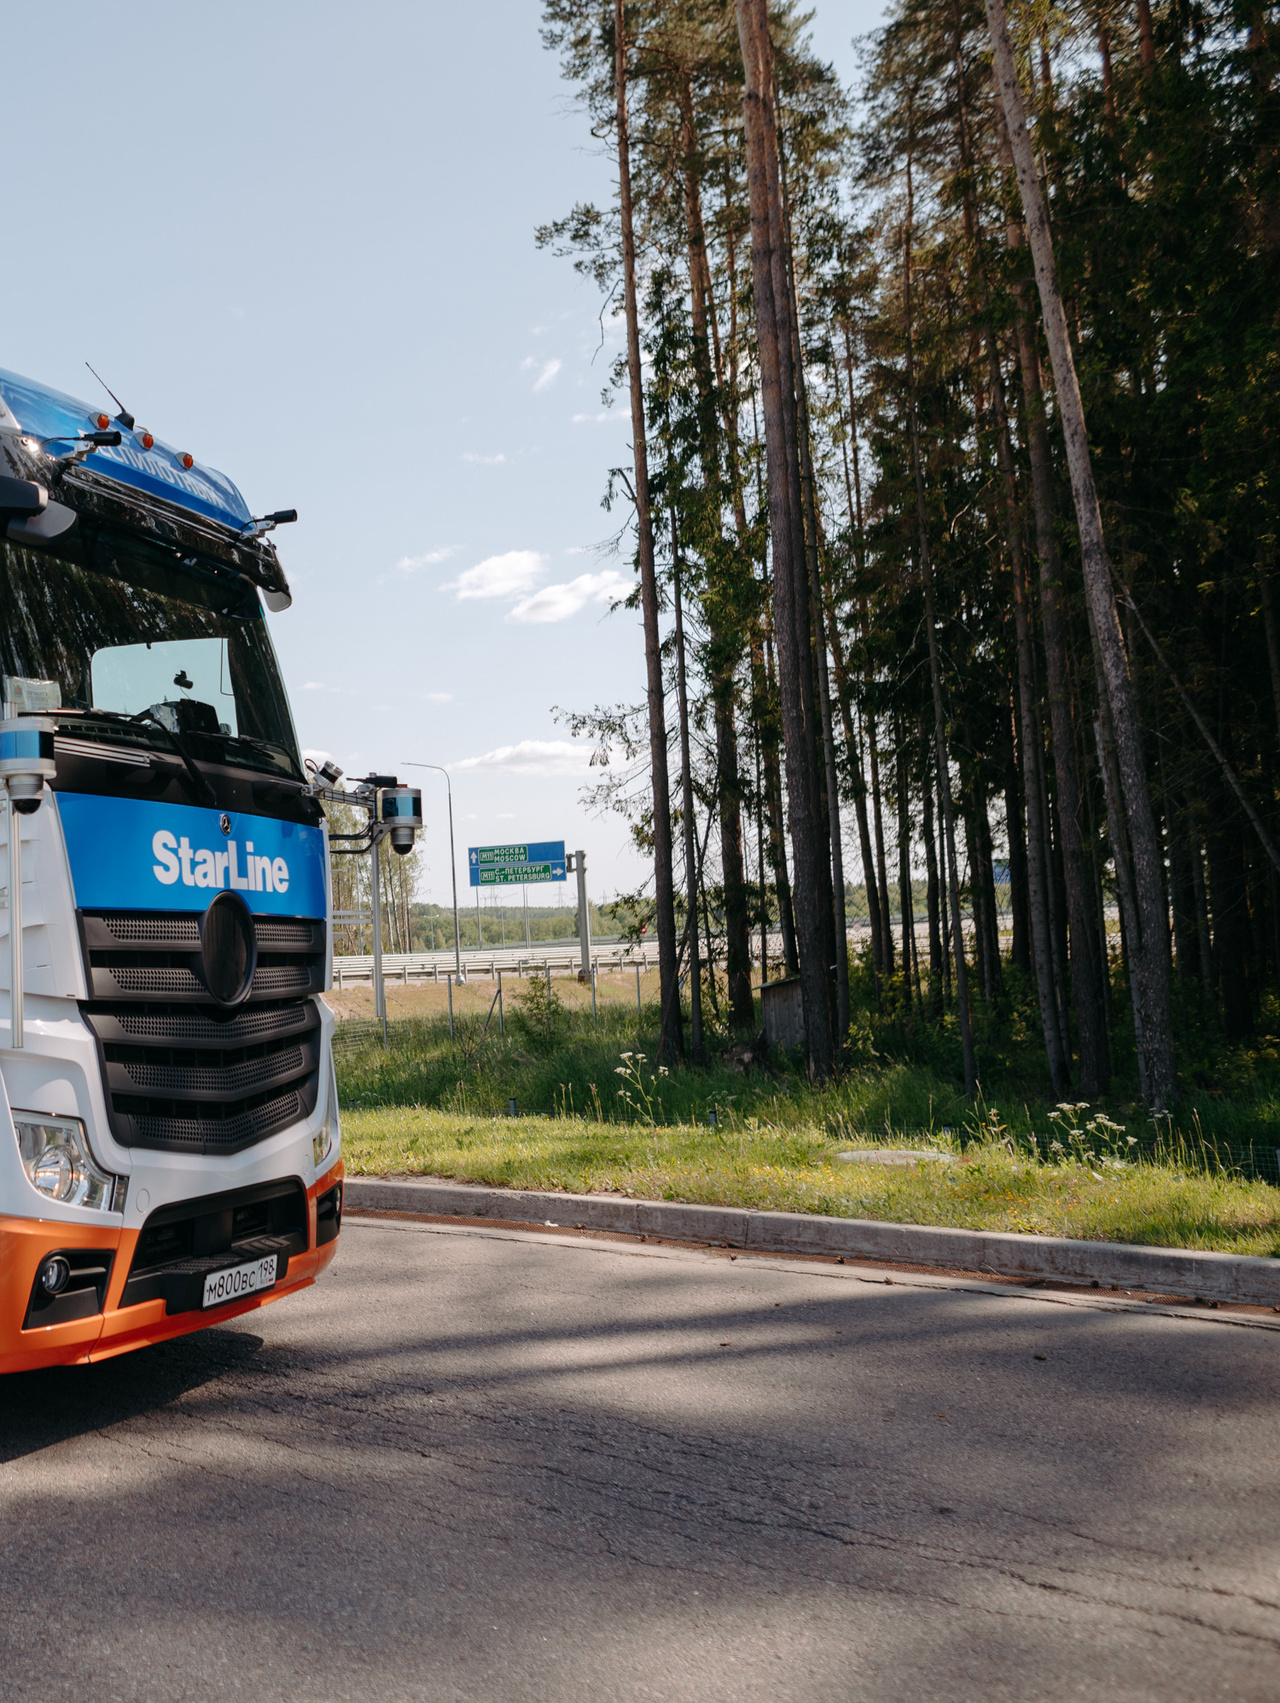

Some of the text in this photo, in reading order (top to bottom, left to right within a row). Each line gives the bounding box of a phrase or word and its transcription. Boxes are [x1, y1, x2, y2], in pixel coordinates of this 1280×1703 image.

[494, 847, 525, 855] МОСКВА
[152, 829, 290, 894] StarLine
[494, 854, 526, 863] MOSCOW
[494, 866, 544, 875] С.-ПЕТЕРБУРГ
[495, 872, 550, 883] ST. PETERSBURG
[259, 1258, 275, 1278] 198
